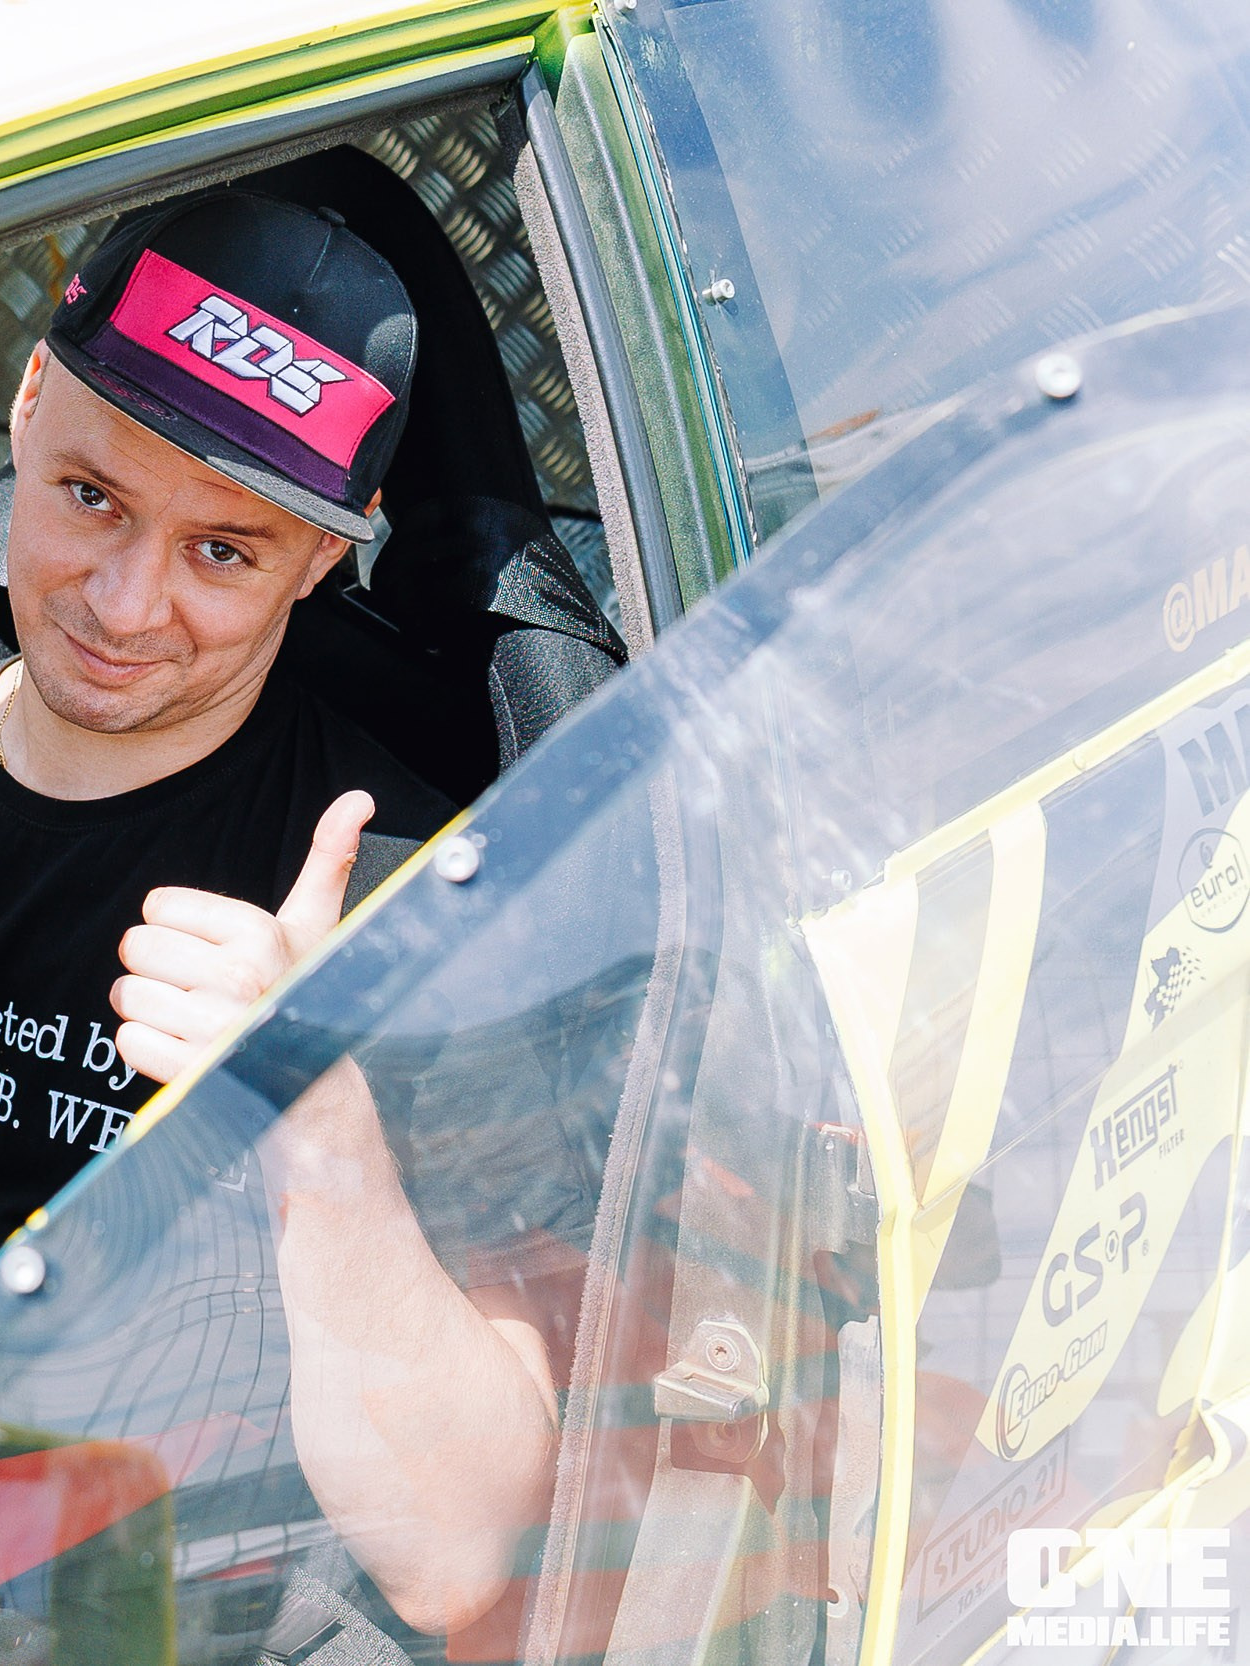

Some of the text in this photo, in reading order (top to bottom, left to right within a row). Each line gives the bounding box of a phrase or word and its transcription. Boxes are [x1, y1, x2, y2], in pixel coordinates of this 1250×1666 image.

[168, 295, 352, 415] RDS
[1178, 704, 1250, 817] M
[1190, 852, 1244, 908] eurol
[1090, 1064, 1178, 1188] Hengst
[1158, 1128, 1186, 1161] FILTER
[931, 1450, 1063, 1588] STUDIO 21
